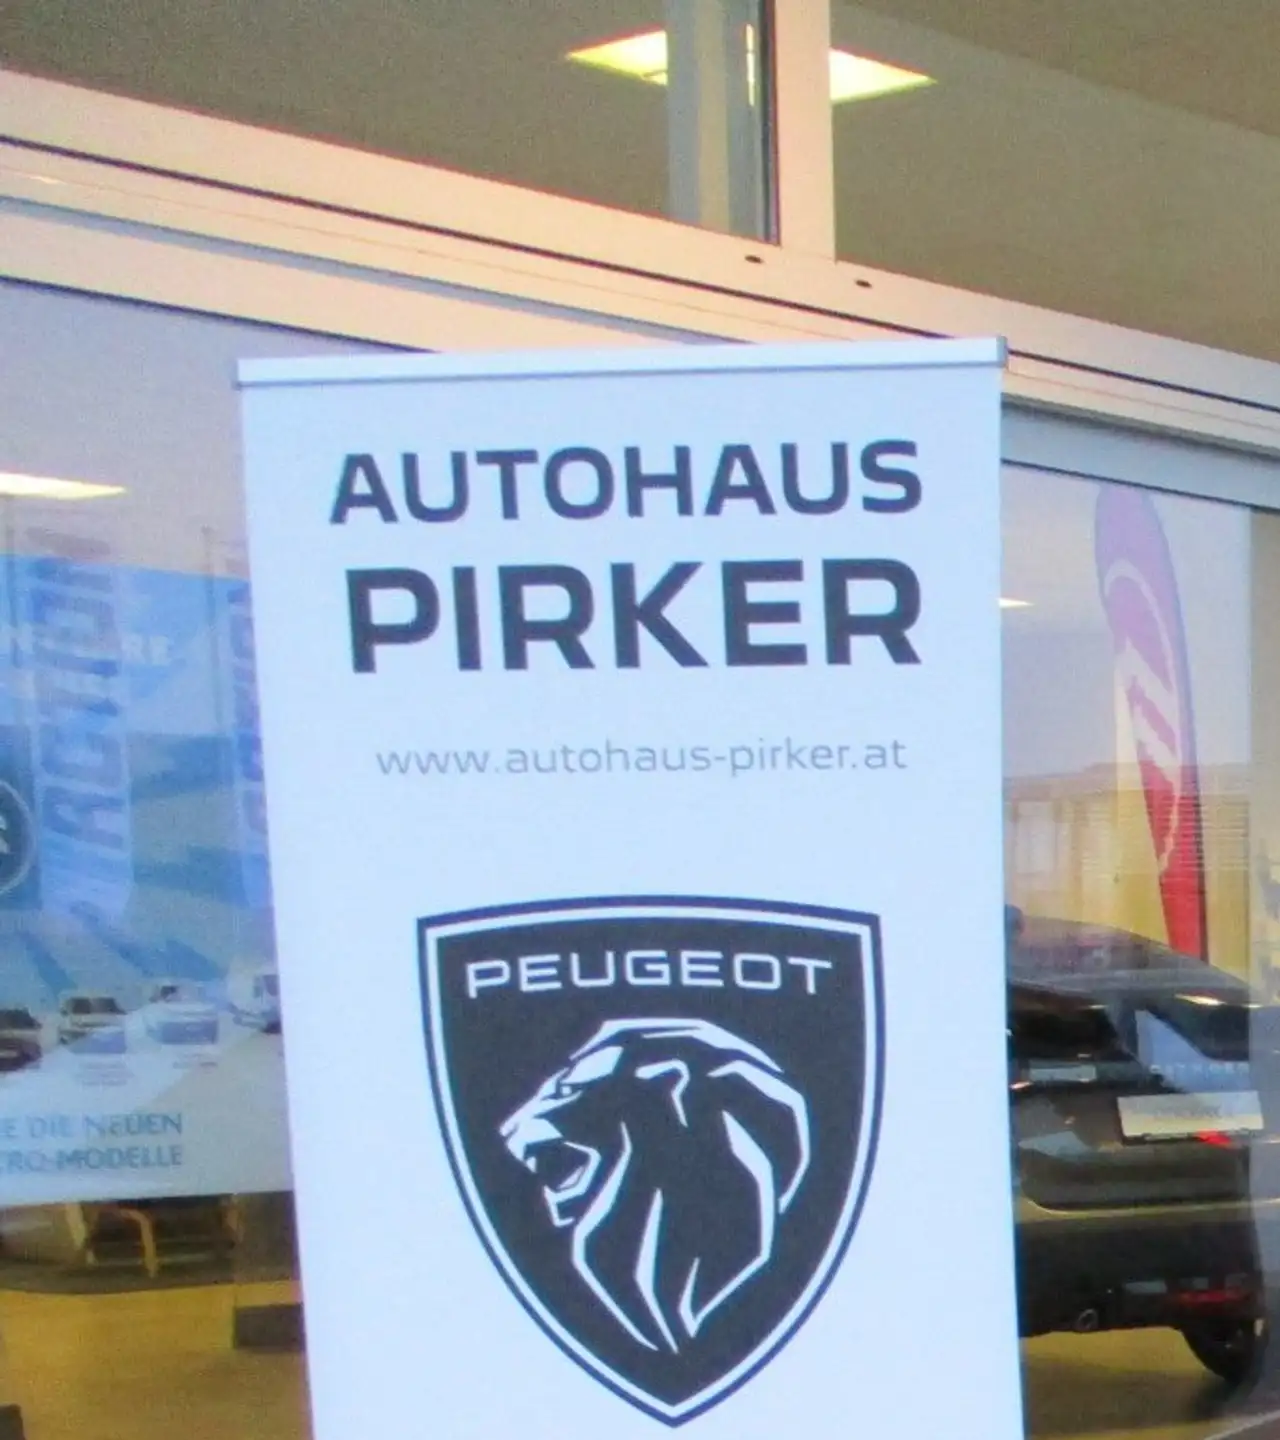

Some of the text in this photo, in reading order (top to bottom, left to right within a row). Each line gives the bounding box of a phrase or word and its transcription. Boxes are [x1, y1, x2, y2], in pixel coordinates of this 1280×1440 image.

[331, 440, 923, 526] AUTOHAUS
[347, 557, 923, 674] PIRKER
[375, 738, 908, 779] www.autohaus-pirker.at
[465, 949, 834, 1000] PEUGEOT
[84, 1112, 183, 1138] NEUEN
